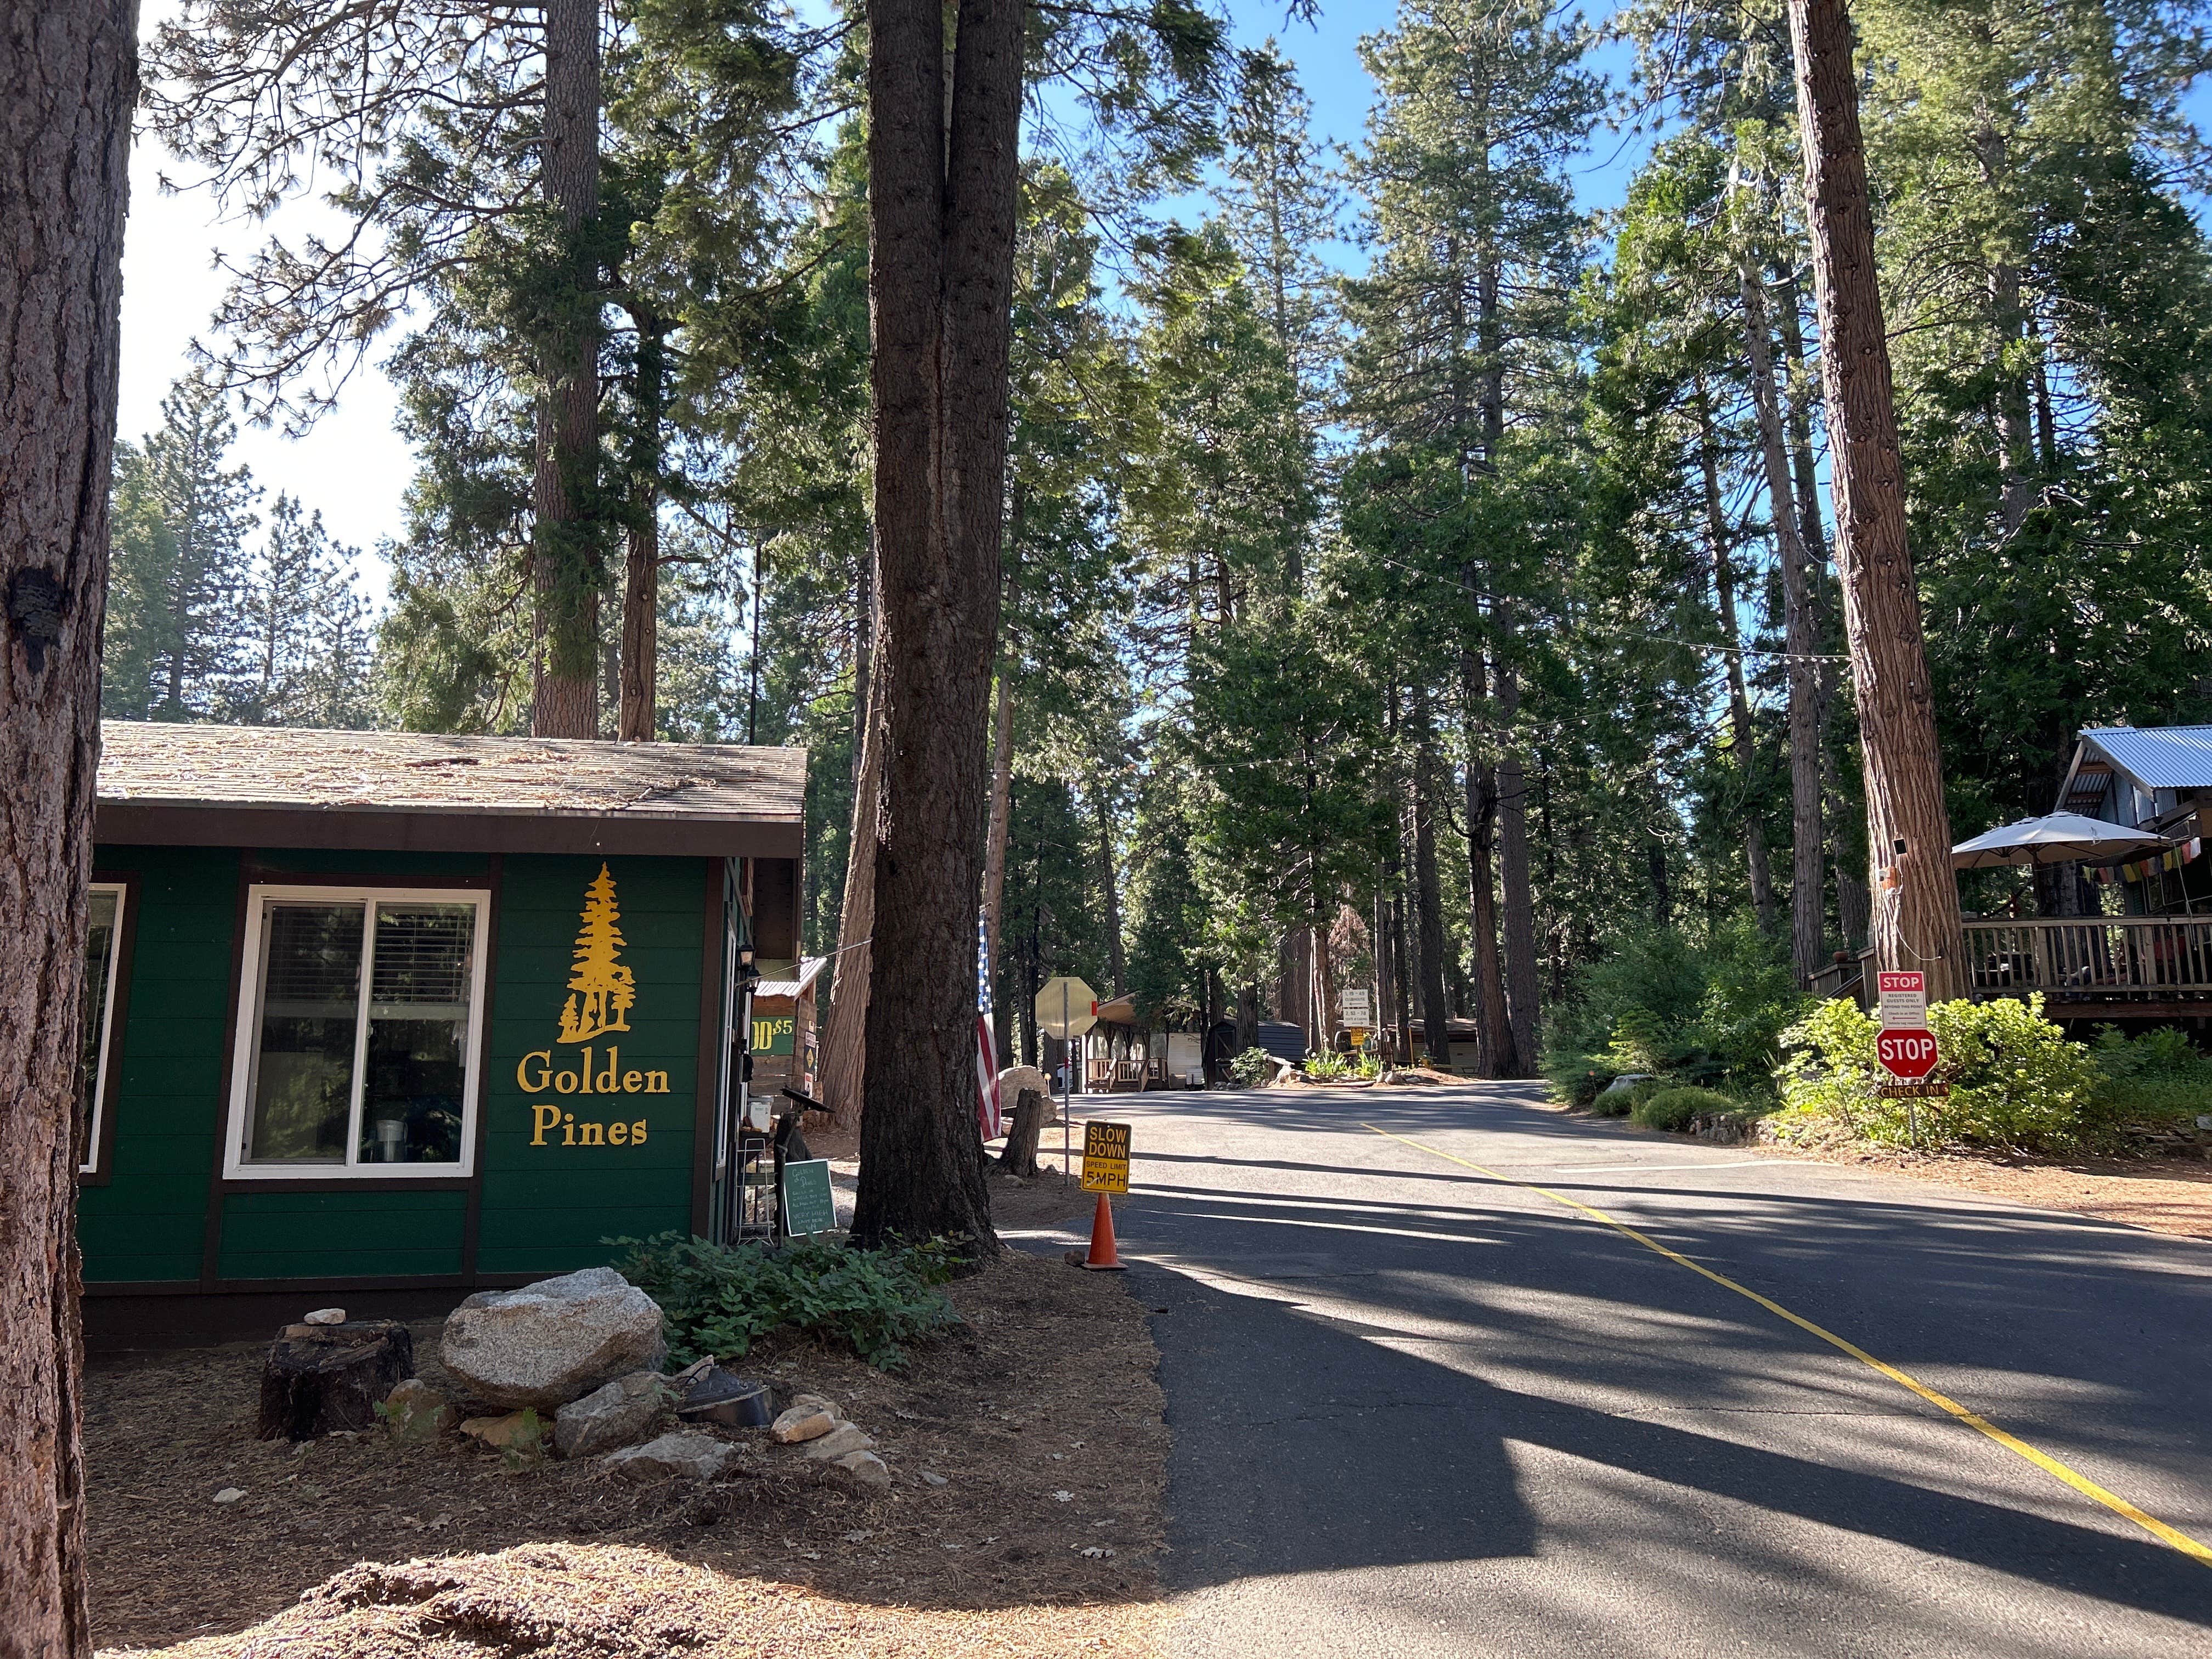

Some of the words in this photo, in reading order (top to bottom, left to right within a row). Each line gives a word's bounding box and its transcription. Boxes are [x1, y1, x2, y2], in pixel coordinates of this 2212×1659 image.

[1883, 977, 1920, 988] STOP
[772, 1019, 793, 1035] $5
[1881, 1038, 1933, 1060] STOP
[517, 1045, 671, 1094] Golden
[1881, 1086, 1921, 1097] CHECK
[1926, 1085, 1939, 1096] IN
[529, 1104, 648, 1146] Pines
[1090, 1126, 1127, 1143] SLOW
[1089, 1142, 1126, 1158] DOWN
[1086, 1161, 1108, 1169] SPEED
[1087, 1171, 1126, 1187] 5MPH
